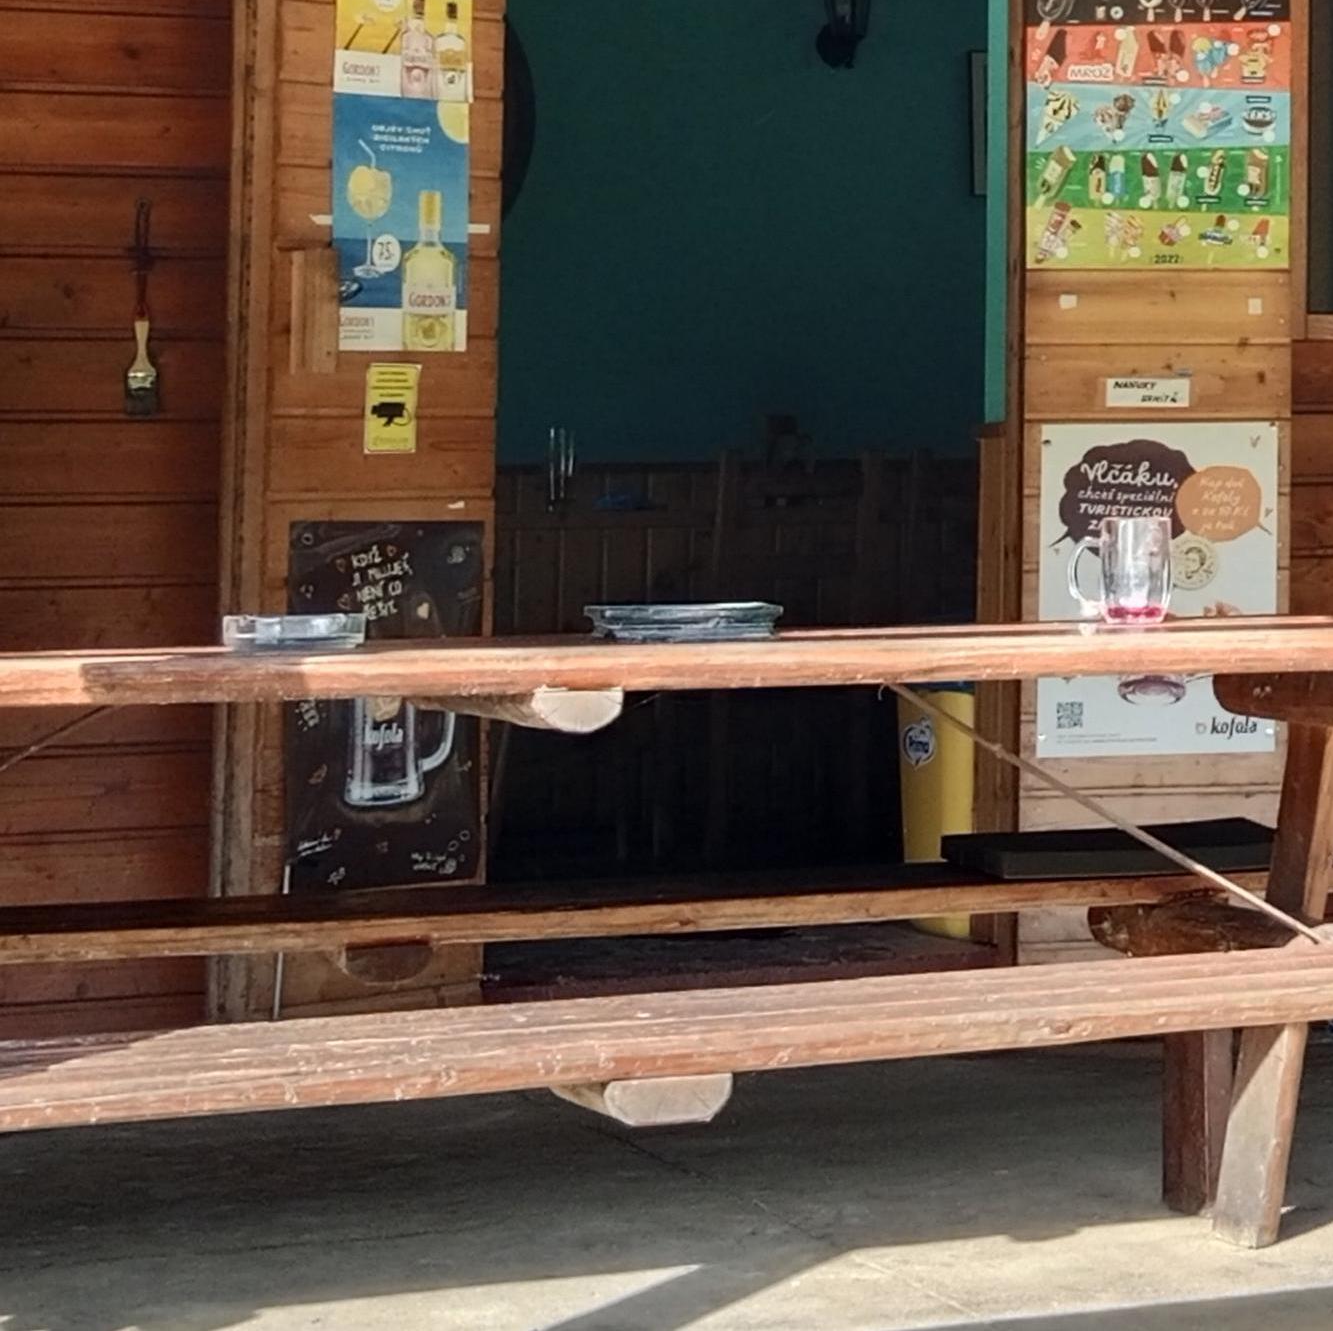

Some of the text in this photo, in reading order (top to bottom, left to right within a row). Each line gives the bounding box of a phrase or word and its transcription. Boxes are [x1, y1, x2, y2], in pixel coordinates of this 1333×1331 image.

[1080, 460, 1178, 488] Vlčáku,
[1116, 489, 1175, 504] speciální
[1079, 503, 1173, 517] TURISTICKOU
[1210, 716, 1258, 740] kofola
